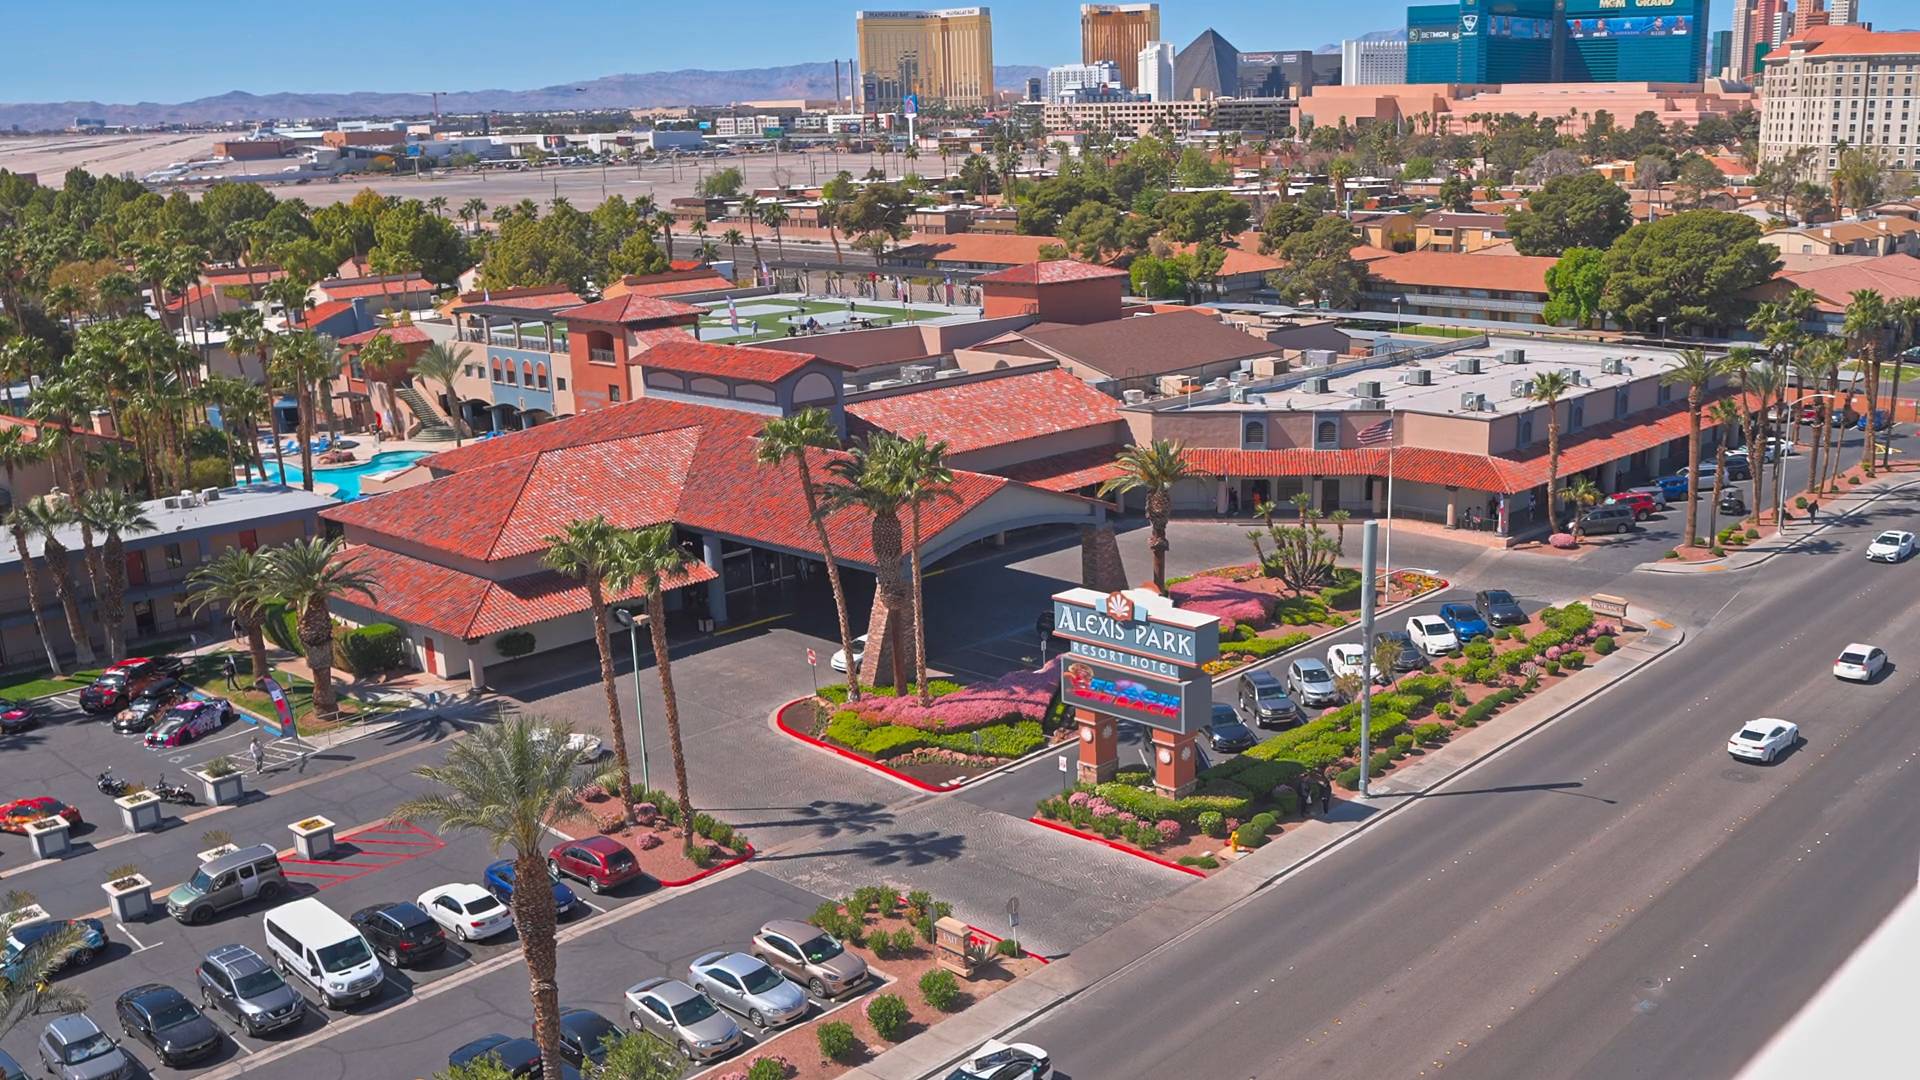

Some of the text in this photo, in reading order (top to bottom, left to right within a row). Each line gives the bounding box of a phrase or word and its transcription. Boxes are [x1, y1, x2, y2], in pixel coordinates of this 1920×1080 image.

[1421, 31, 1449, 39] BETMGM
[1058, 606, 1192, 656] ALEXIS PARK
[1072, 642, 1176, 676] RESORT HOTEL
[943, 932, 957, 945] EXIT
